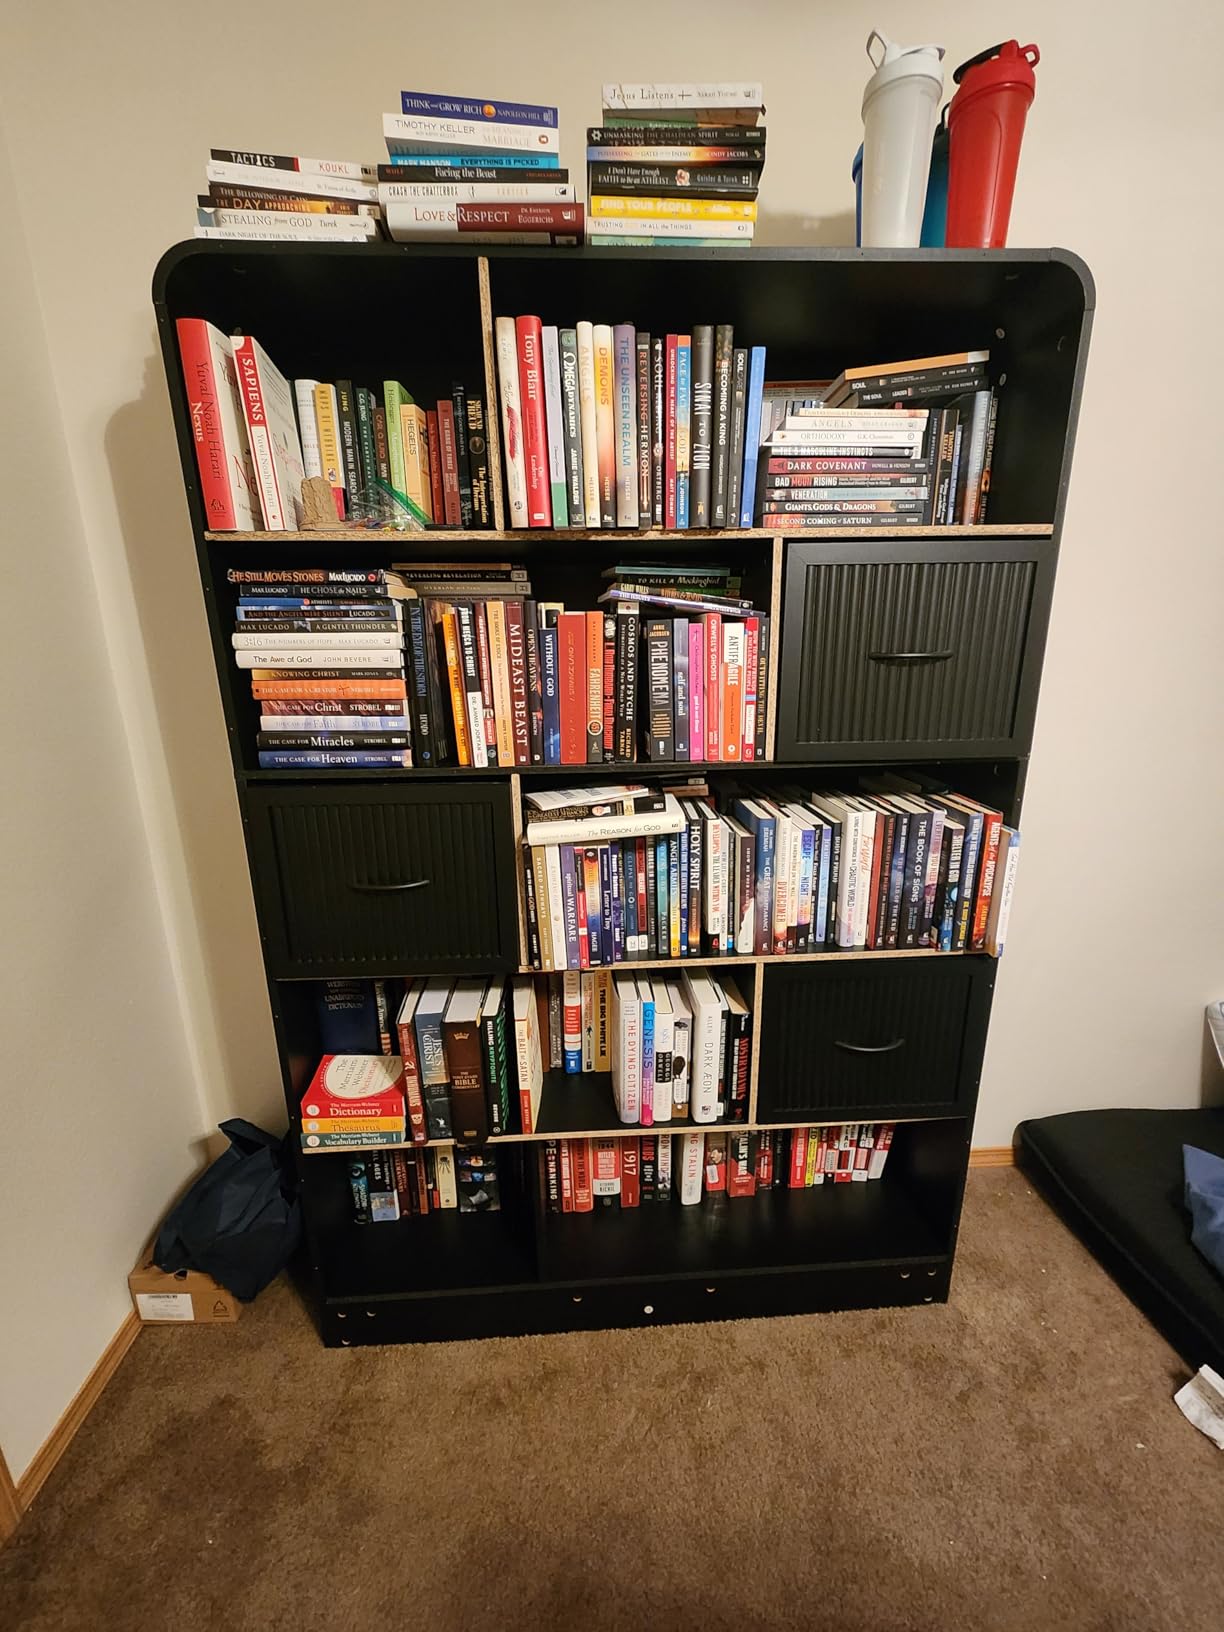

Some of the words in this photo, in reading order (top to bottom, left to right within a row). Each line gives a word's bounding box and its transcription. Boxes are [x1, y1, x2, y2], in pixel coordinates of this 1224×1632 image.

[610, 87, 636, 101] Jesus
[640, 88, 675, 101] Listens
[406, 98, 431, 110] THINK
[440, 102, 461, 115] GROW
[463, 105, 482, 116] RICH
[395, 119, 437, 132] TIMOTHY
[439, 123, 475, 138] KELLER
[230, 152, 276, 170] TACTICS
[318, 162, 350, 175] KOUKL
[434, 168, 460, 184] Facing
[476, 169, 497, 182] Beast
[389, 186, 408, 197] CRASH
[422, 187, 459, 198] CHATTERBOX
[220, 214, 272, 226] STEALING
[289, 215, 313, 227] GOD
[318, 217, 338, 228] Turek
[415, 208, 445, 223] LOVE
[446, 212, 456, 223] &
[457, 206, 511, 224] RESPECT
[517, 215, 553, 227] EGGERICHS
[523, 333, 538, 366] Tony
[620, 337, 630, 360] THE
[196, 362, 214, 401] Yuval
[526, 368, 539, 401] Blair
[598, 346, 611, 406] DEMONS
[638, 351, 649, 421] REVERSING
[719, 361, 730, 412] BECOMING
[243, 357, 265, 422] SAPIENS
[340, 391, 348, 412] JUNG
[621, 368, 631, 422] UNSEEN
[693, 382, 713, 416] SINAI
[191, 401, 204, 442] Nexus
[202, 401, 217, 436] Noah
[467, 400, 479, 430] FREUD
[343, 420, 352, 447] MODERN
[406, 418, 418, 456] HEGEL'S
[698, 420, 707, 438] TO
[718, 422, 728, 447] KING
[622, 424, 632, 467] REALM
[640, 425, 649, 477] HERMON
[692, 443, 711, 471] ZION
[946, 431, 955, 463] TIMOTHY
[208, 439, 225, 481] Harari
[570, 448, 579, 470] JAMIE
[787, 461, 812, 471] DARK
[815, 461, 867, 471] COVENANT
[478, 466, 488, 478] The
[530, 455, 540, 489] Leadership
[655, 465, 663, 502] ORTBERG
[774, 477, 790, 487] BAD
[791, 477, 813, 487] MOON
[813, 477, 838, 487] RISING
[473, 486, 482, 511] Dreams
[479, 480, 491, 523] Interpretation
[572, 475, 580, 506] WALDEN
[678, 486, 687, 515] JOHNSON
[790, 488, 828, 500] VENERATION
[813, 502, 834, 512] GODS
[843, 502, 877, 512] DRAGONS
[292, 571, 325, 585] STONES
[328, 571, 342, 583] MAX
[342, 572, 366, 585] LUCADO
[349, 610, 376, 620] LUCADO
[240, 624, 257, 632] MAX
[258, 624, 290, 633] LUCADO
[527, 628, 537, 652] OPEN
[626, 617, 636, 659] COSMOS
[710, 619, 718, 653] ORWELL'S
[253, 655, 268, 665] The
[269, 655, 285, 665] Awe
[287, 655, 295, 665] of
[296, 655, 313, 665] God
[323, 656, 342, 665] JOHN
[344, 656, 372, 665] BEVERE
[509, 623, 526, 696] MIDEAST
[545, 634, 554, 676] WITHOUT
[710, 653, 718, 681] GHOSTS
[727, 635, 740, 686] ANTIFRAGILE
[271, 671, 312, 680] KNOWING
[312, 670, 340, 679] CHRIST
[528, 653, 539, 692] HEAVENS
[626, 660, 636, 682] AND
[651, 641, 671, 706] PHENOMENA
[677, 671, 686, 686] self
[546, 677, 555, 697] GOD
[589, 668, 601, 720] FAHRENHEIT
[678, 686, 686, 700] and
[349, 704, 382, 713] STROBEL
[625, 685, 635, 721] PSYCHE
[677, 700, 686, 717] soul
[514, 701, 528, 747] BEAST
[268, 738, 277, 747] THE
[278, 738, 295, 747] CASE
[295, 738, 310, 747] FOR
[310, 735, 355, 750] Miracles
[363, 737, 387, 746] STROBEL
[274, 757, 288, 766] THE
[289, 757, 305, 766] CASE
[306, 757, 321, 766] FOR
[321, 754, 358, 767] Heaven
[364, 756, 388, 765] STROBEL
[599, 828, 632, 839] REASON
[643, 824, 661, 834] GOD
[688, 825, 702, 855] HOLY
[711, 824, 721, 855] DEVELOPING
[917, 820, 928, 837] THE
[988, 821, 1002, 846] AGENTS
[669, 840, 678, 866] ANGEL
[802, 834, 813, 860] ESCAPE
[858, 835, 873, 875] Forward
[914, 838, 927, 863] BOOK
[951, 835, 964, 860] SHELTER
[536, 857, 544, 883] SACRED
[670, 867, 678, 896] ARMIES
[688, 858, 701, 891] SPIRIT
[763, 866, 772, 889] GREAT
[848, 866, 858, 889] CHAOTIC
[914, 864, 923, 876] OF
[947, 869, 960, 883] GOD
[981, 860, 997, 897] APOCALYPSE
[564, 873, 574, 897] spiritual
[799, 876, 810, 897] NIGHT
[910, 878, 922, 903] SIGNS
[538, 885, 547, 919] PATHWAYS
[603, 890, 611, 908] Letter
[776, 881, 788, 923] OVERCOMER
[847, 889, 857, 907] WORLD
[566, 897, 577, 942] WARFARE
[603, 917, 612, 930] Troy
[599, 989, 607, 1004] THE
[599, 1005, 607, 1019] BIG
[706, 1015, 714, 1034] ALLEN
[486, 1020, 495, 1046] KILLING
[599, 1020, 607, 1045] WHITE
[627, 1019, 638, 1037] THE
[642, 1008, 654, 1070] GENESIS
[421, 1034, 435, 1066] CHRIST
[432, 1038, 444, 1067] JESUS
[599, 1045, 607, 1057] LIE
[627, 1041, 638, 1070] DYING
[702, 1042, 714, 1068] DARK
[488, 1046, 497, 1084] KRYPTONITE
[656, 1053, 665, 1082] ORWELL
[664, 1053, 672, 1082] GEORGE
[627, 1074, 638, 1112] CITIZEN
[329, 1107, 383, 1119] Dictionary
[331, 1123, 382, 1135] Thesaurus
[324, 1137, 362, 1149] Vocabulary
[362, 1135, 388, 1147] Builder
[623, 1150, 637, 1176] 1917
[687, 1148, 699, 1179] STALIN
[737, 1160, 749, 1176] WAR
[547, 1161, 559, 1201] NANKING
